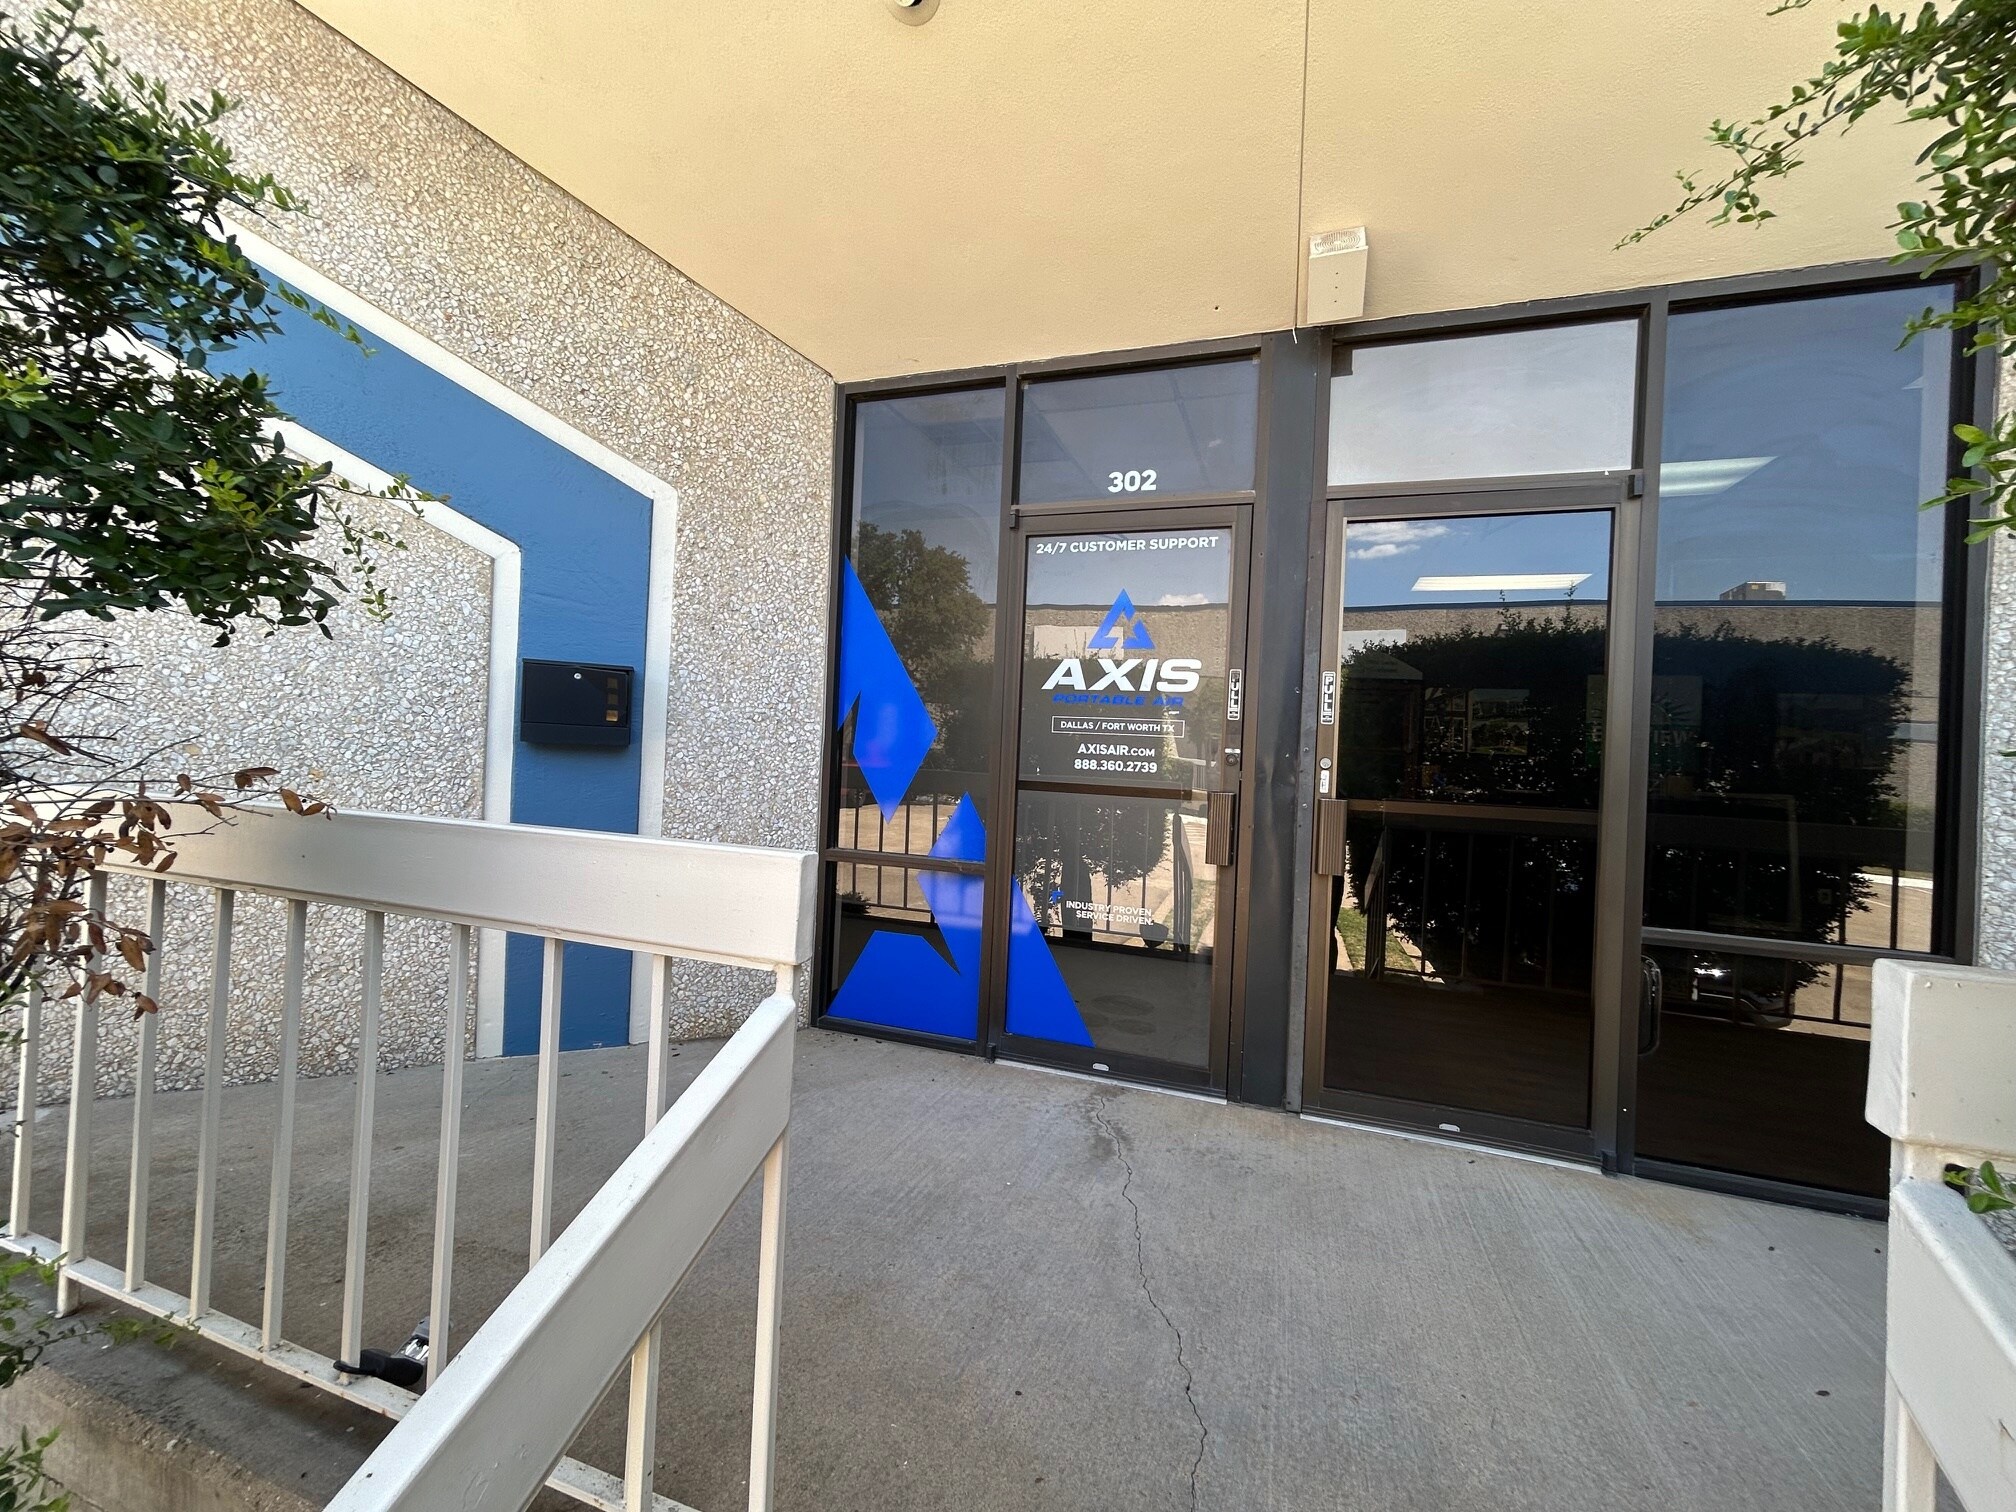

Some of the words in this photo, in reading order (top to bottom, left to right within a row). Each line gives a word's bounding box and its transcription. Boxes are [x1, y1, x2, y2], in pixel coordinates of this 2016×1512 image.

[1107, 469, 1157, 493] 302
[1035, 542, 1067, 555] 24/7
[1069, 539, 1146, 553] CUSTOMER
[1149, 536, 1219, 550] SUPPORT
[1041, 658, 1202, 693] AXIS
[1053, 694, 1145, 706] PORTABLE
[1152, 696, 1184, 706] AIR
[1324, 676, 1333, 711] PULL
[1060, 720, 1094, 730] DALLAS
[1101, 722, 1126, 732] FORT
[1127, 723, 1161, 733] WORTH
[1162, 724, 1175, 733] TX
[1073, 759, 1158, 773] 888.360.2739
[1066, 900, 1110, 911] INDUSTRY
[1076, 910, 1114, 921] SERVICE
[1116, 914, 1154, 925] DRIVEN.
